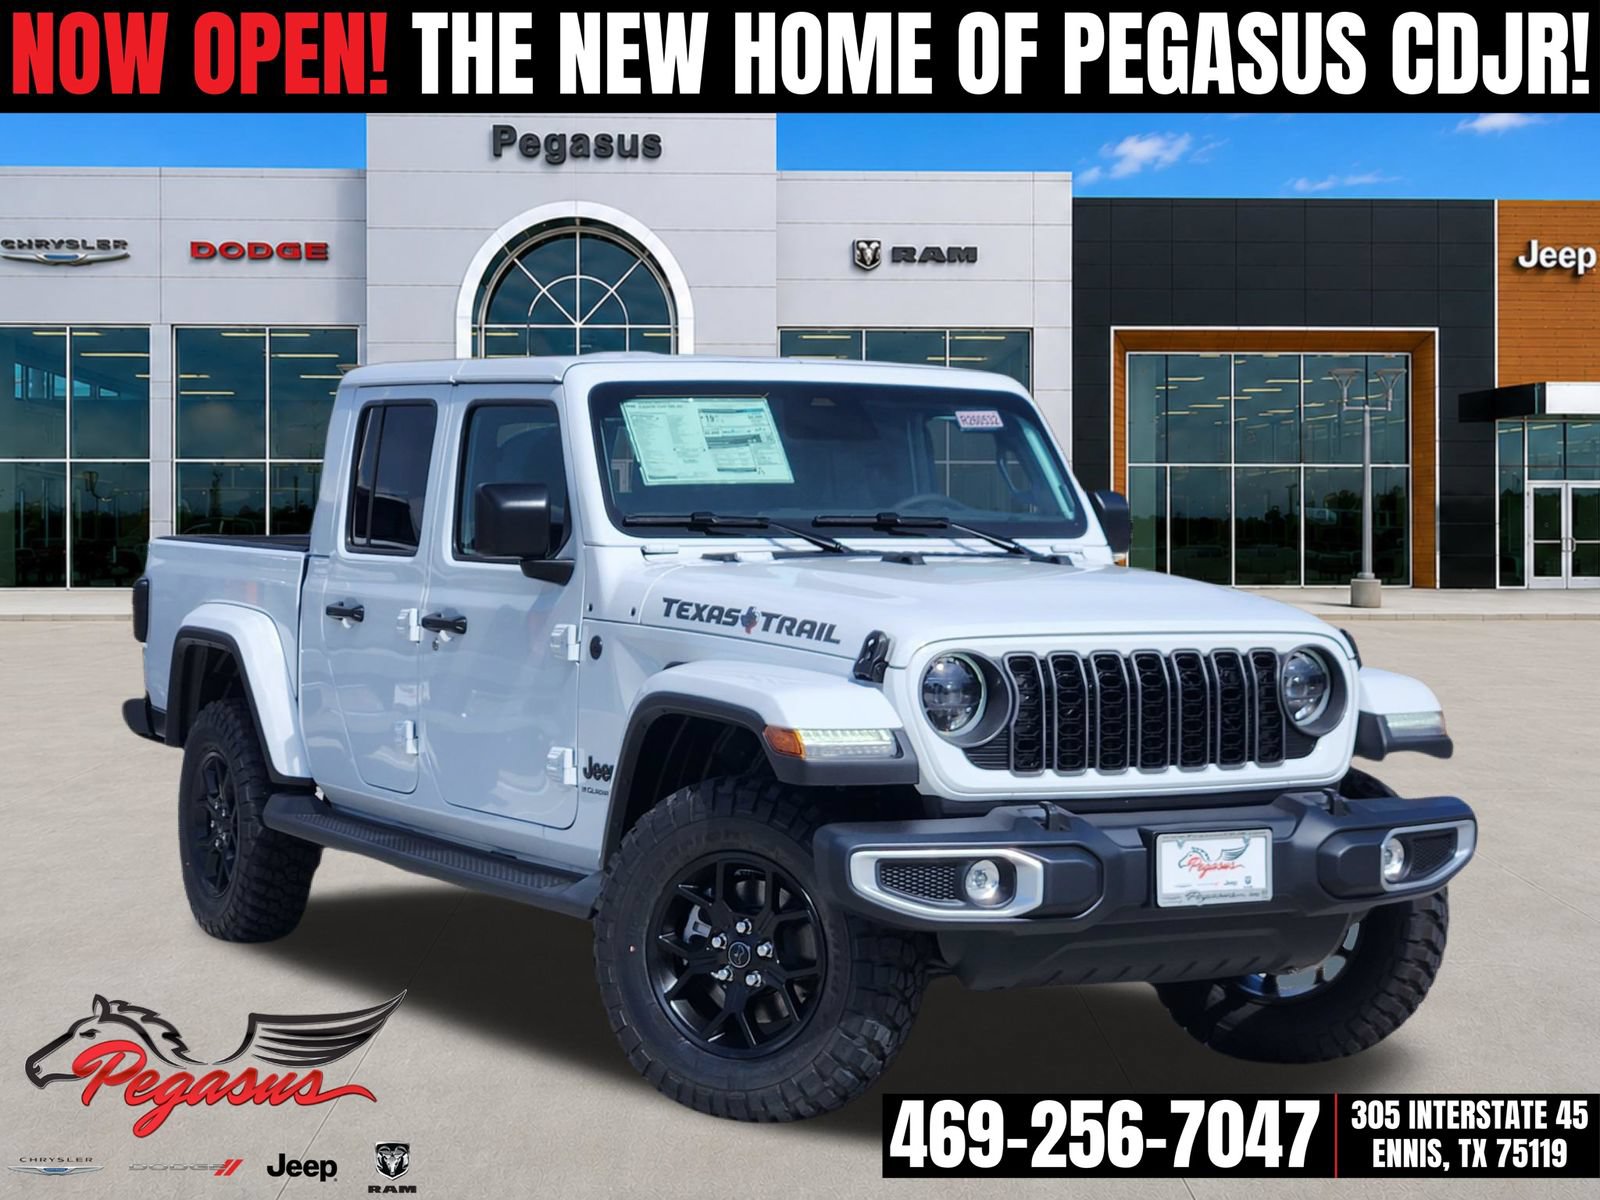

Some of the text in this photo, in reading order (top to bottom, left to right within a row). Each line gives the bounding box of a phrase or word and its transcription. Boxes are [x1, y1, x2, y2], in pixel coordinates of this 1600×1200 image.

[492, 124, 662, 166] Pegasus
[0, 238, 129, 251] CHRYSLER
[190, 241, 328, 260] DODGE
[891, 246, 978, 264] RAM
[1518, 239, 1597, 275] Jeep
[662, 597, 841, 644] TEXAS TRAIL
